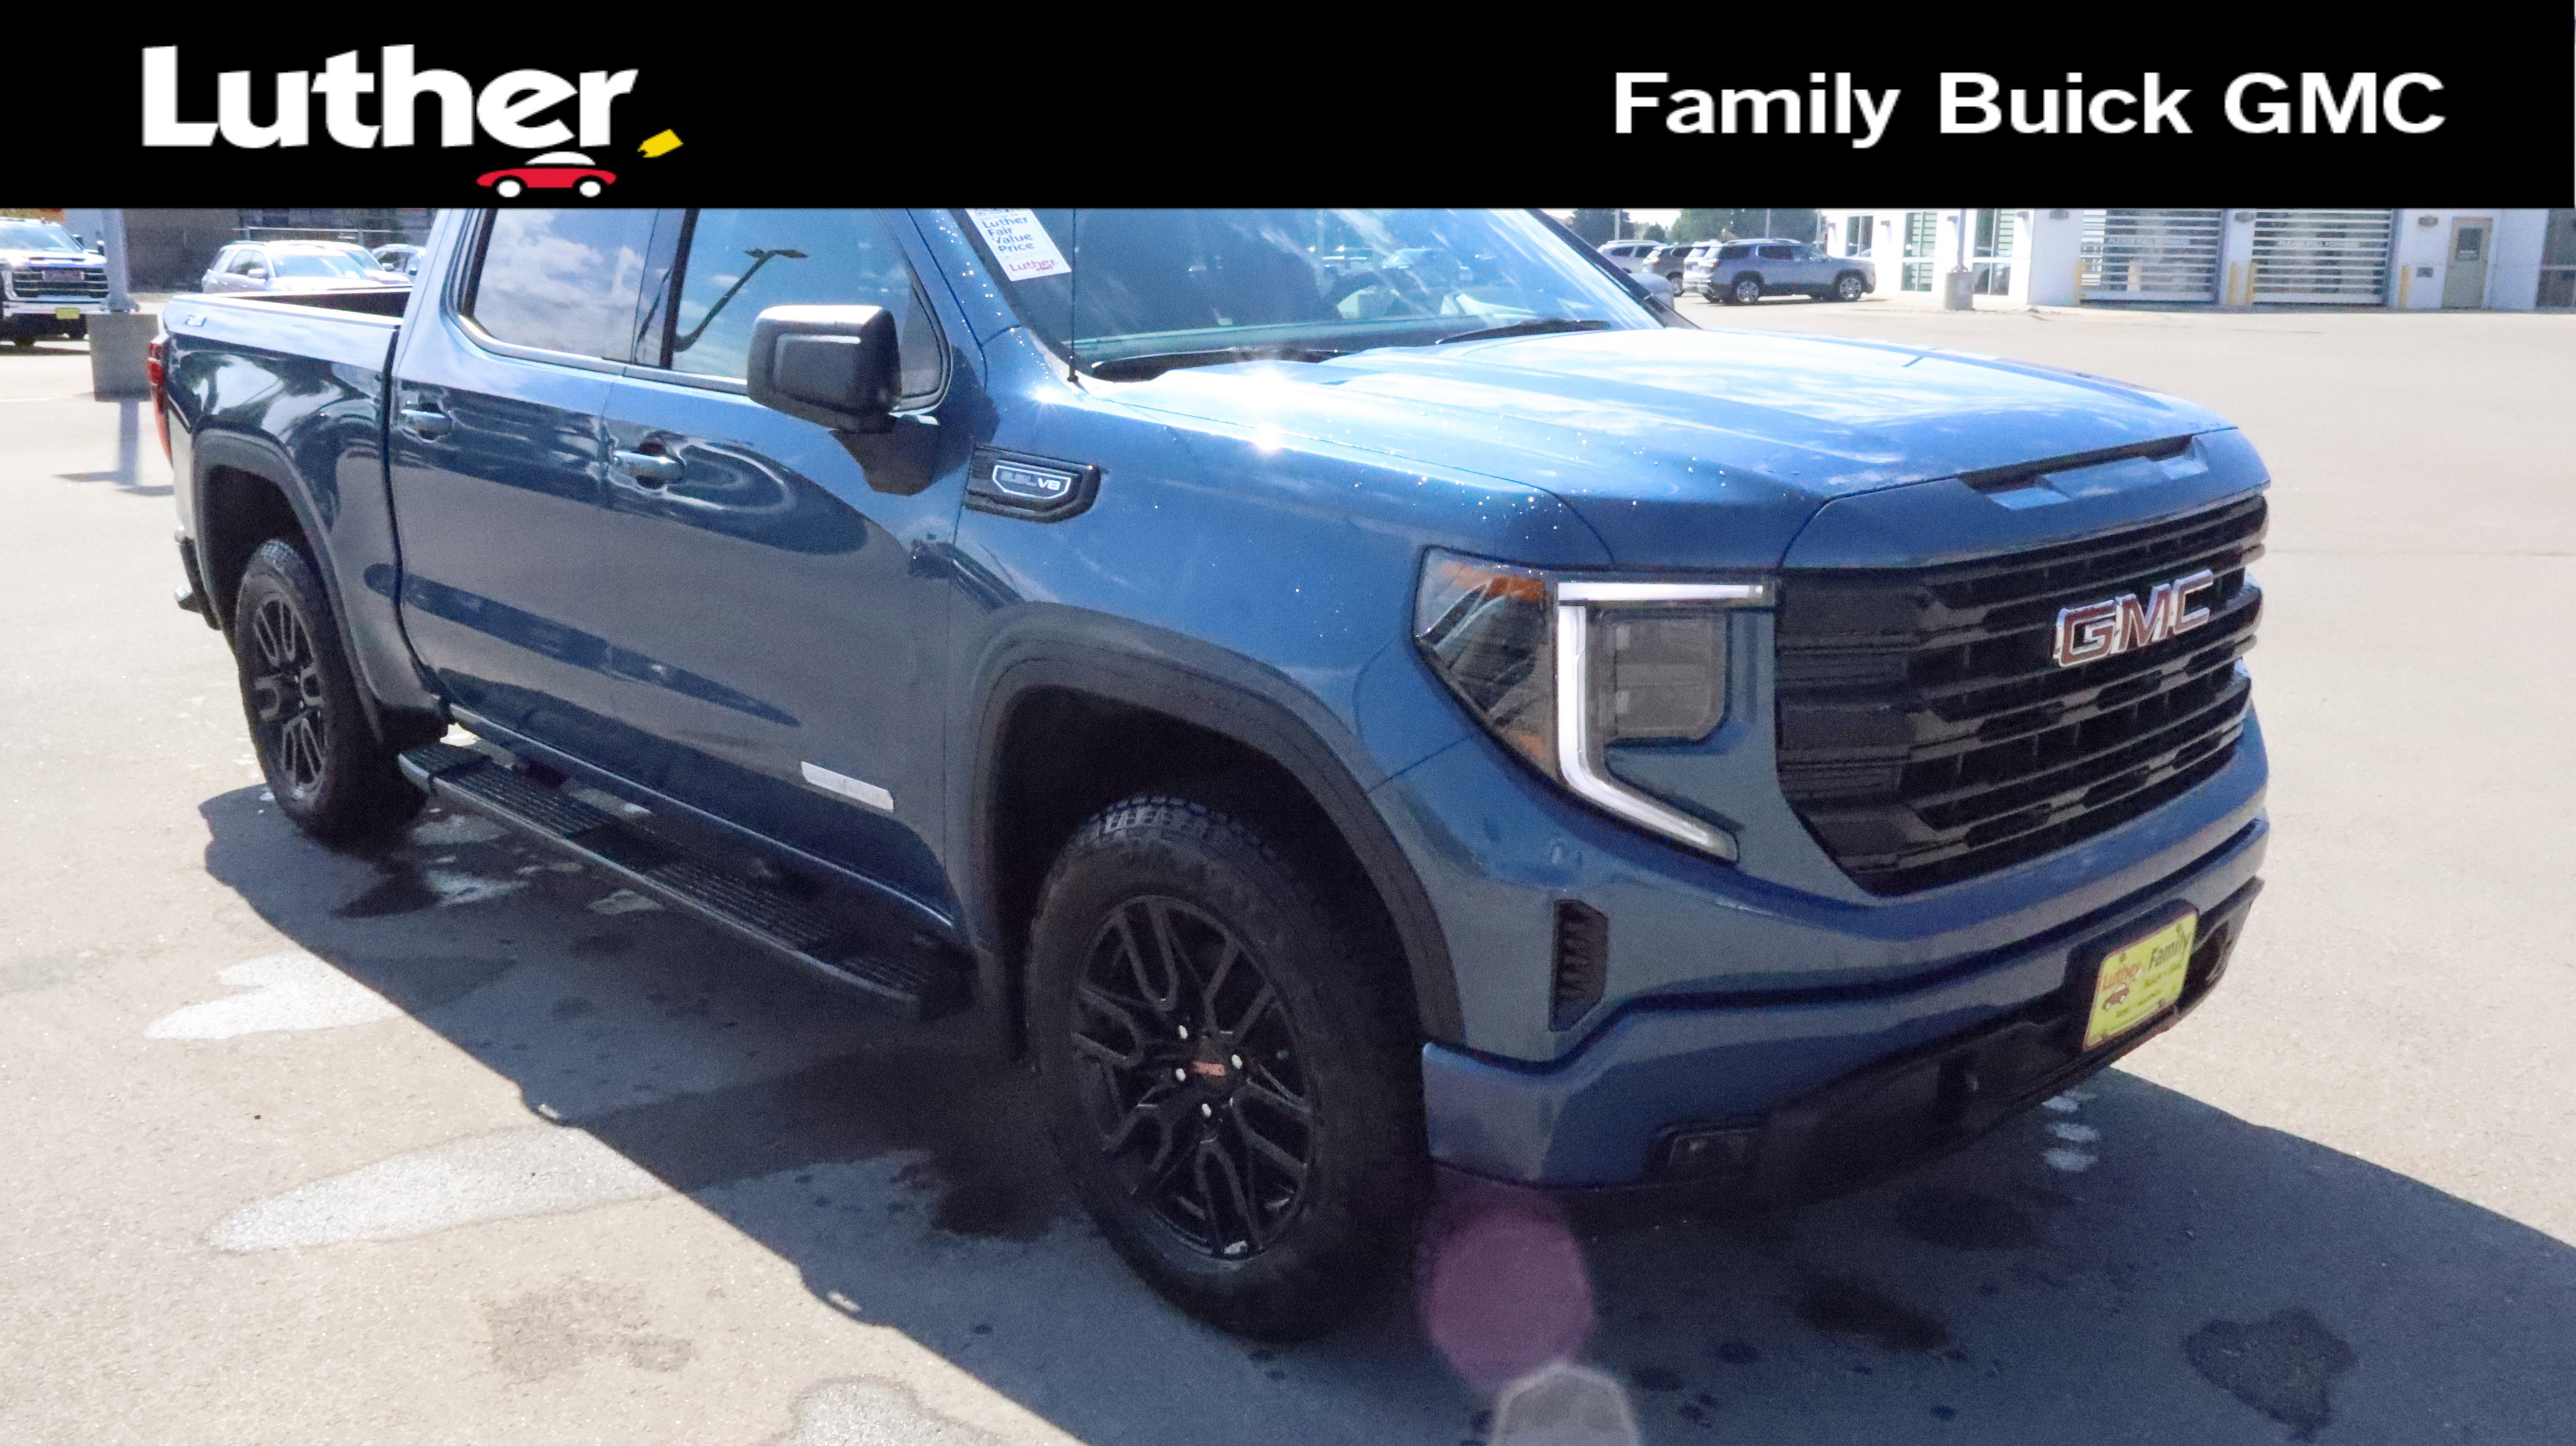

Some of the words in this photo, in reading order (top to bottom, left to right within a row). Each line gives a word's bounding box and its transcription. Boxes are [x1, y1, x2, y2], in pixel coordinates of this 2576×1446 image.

[982, 217, 1028, 229] Luther
[987, 226, 1013, 237] Fair
[991, 233, 1034, 244] Value
[998, 242, 1035, 252] Price
[1009, 259, 1055, 271] Luther
[1038, 478, 1060, 491] V8
[2053, 568, 2214, 667] GMC
[2148, 932, 2191, 971] Family
